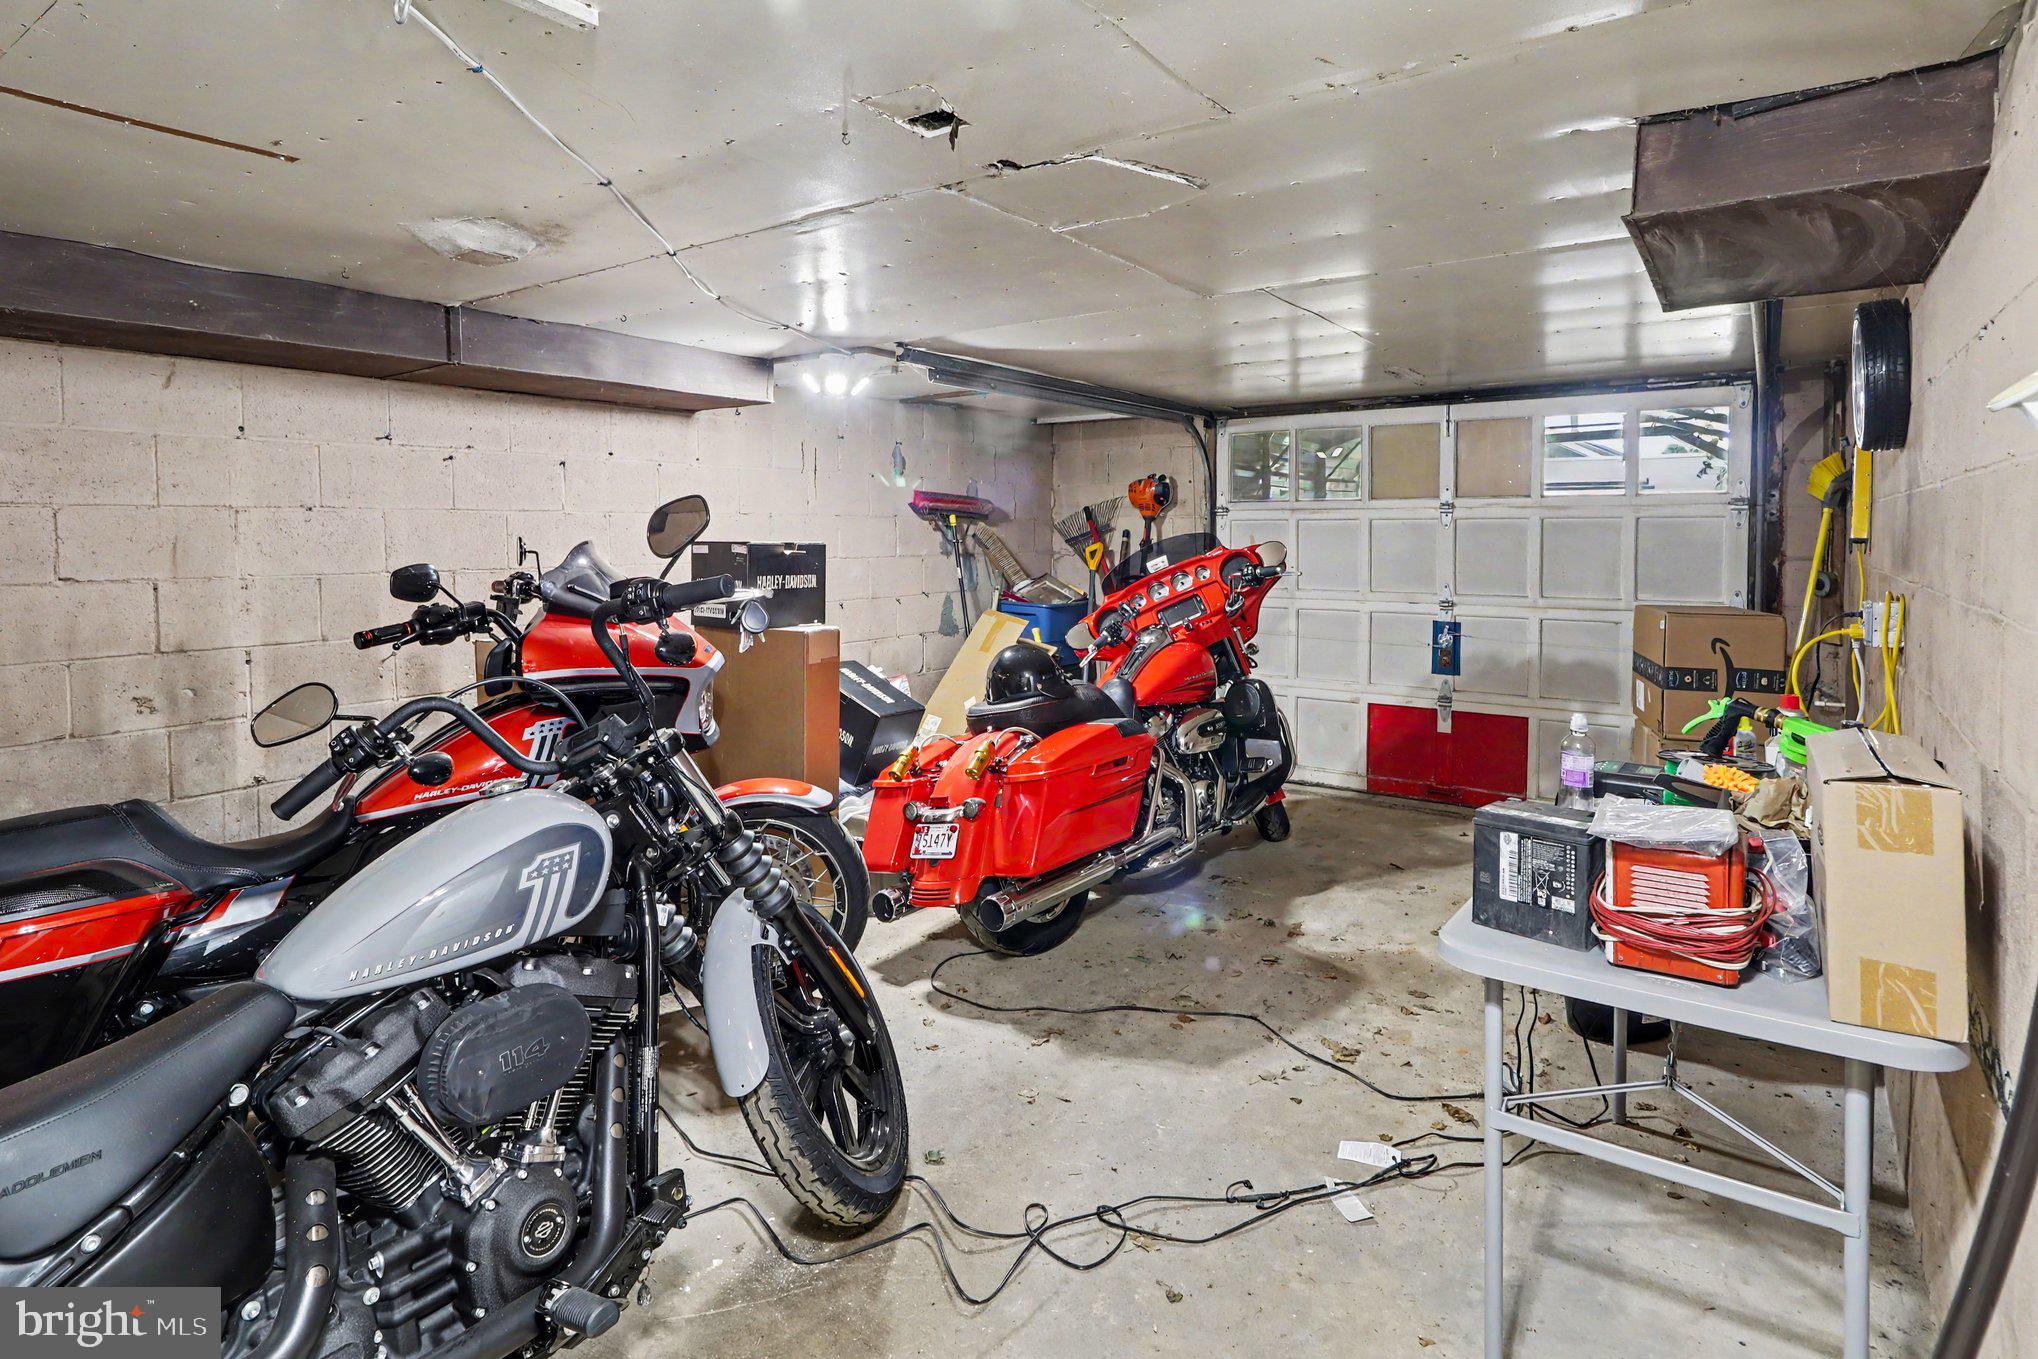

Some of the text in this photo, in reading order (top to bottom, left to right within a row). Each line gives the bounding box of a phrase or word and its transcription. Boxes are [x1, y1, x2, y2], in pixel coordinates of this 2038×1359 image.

[757, 574, 818, 590] HARLEY-DAVIDSON
[348, 924, 515, 982] HARLEY-DAVIDSON
[499, 1036, 551, 1072] 114
